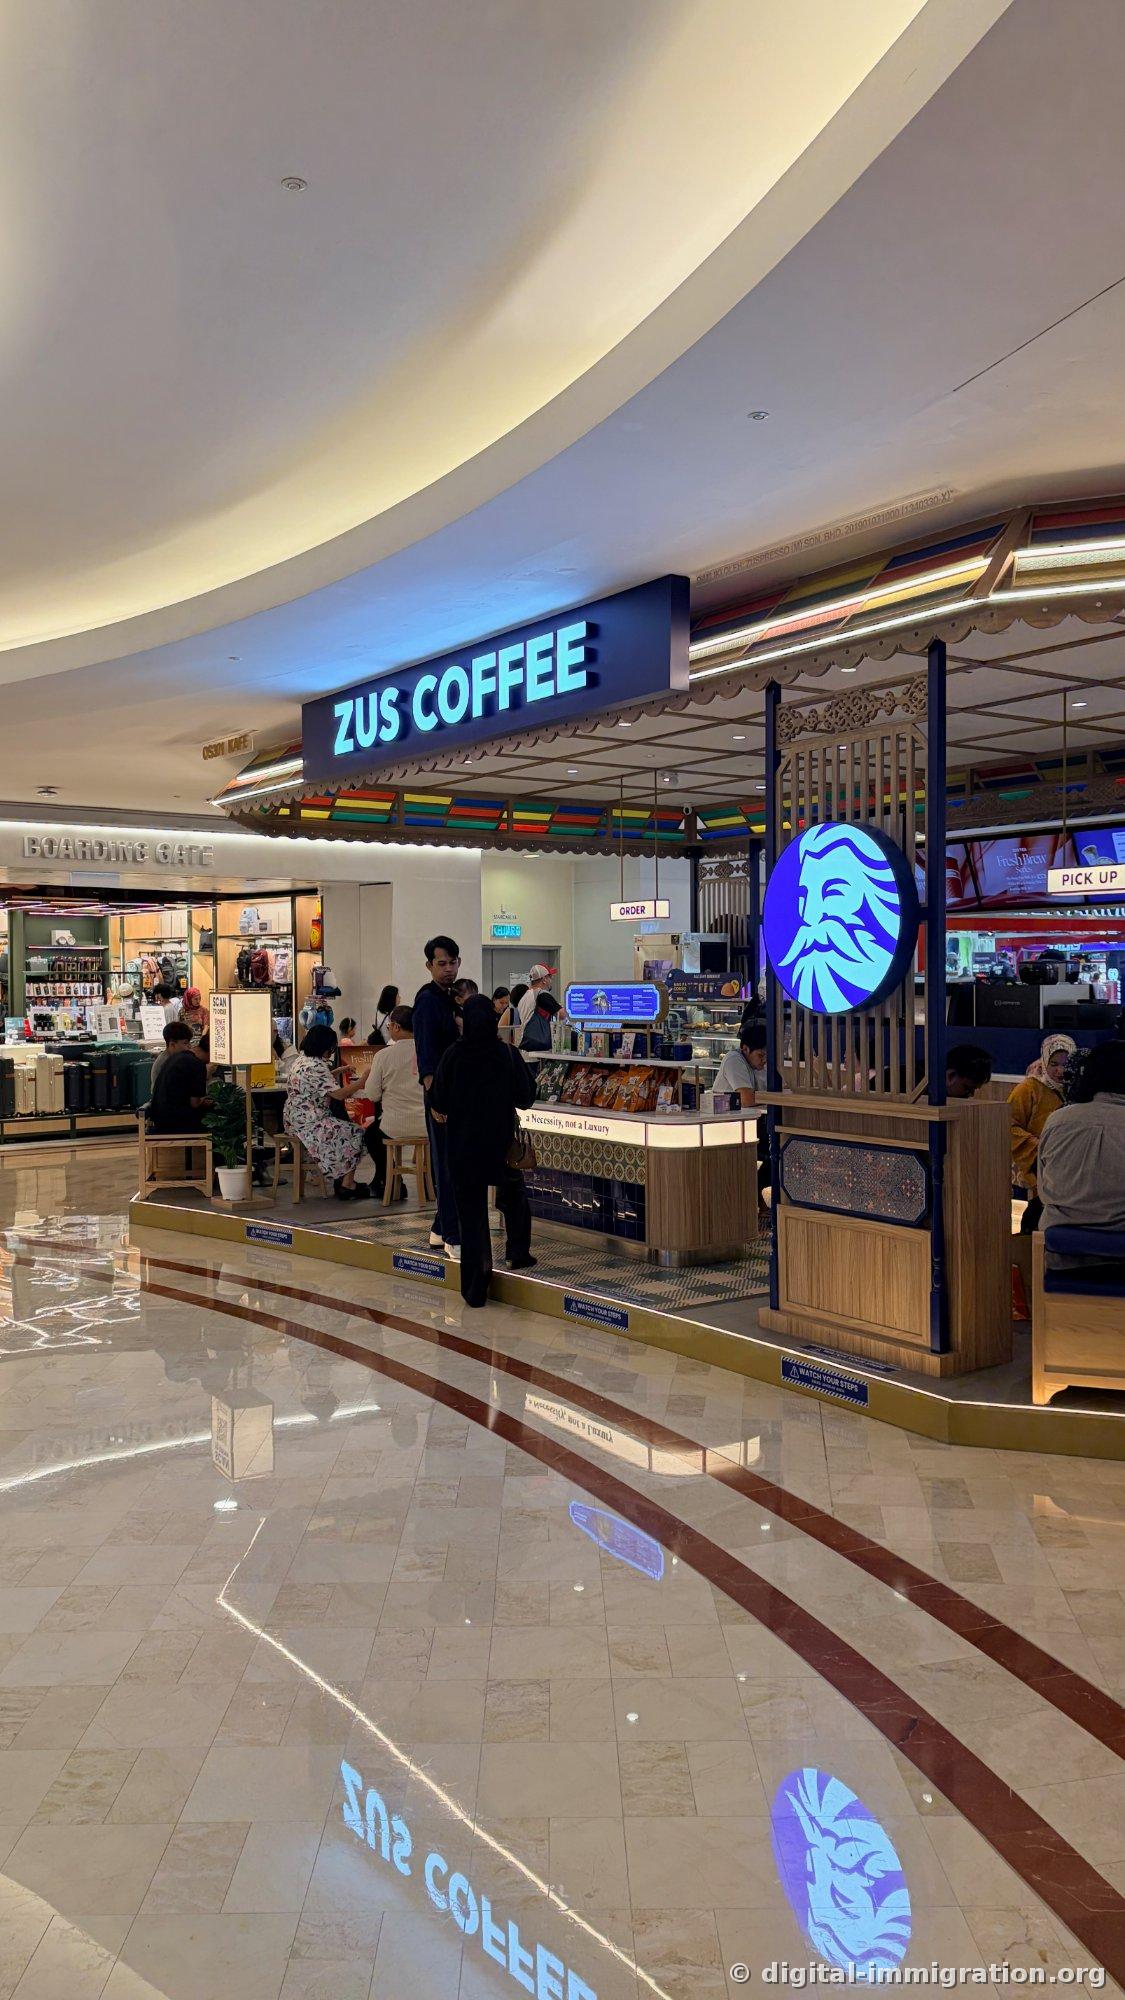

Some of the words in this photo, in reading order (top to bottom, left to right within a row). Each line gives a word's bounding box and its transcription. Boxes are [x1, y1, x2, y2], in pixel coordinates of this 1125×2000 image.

[334, 687, 400, 756] ZUS
[412, 620, 587, 732] COFFEE
[228, 735, 248, 753] KAFE
[23, 835, 149, 863] BOARDING
[155, 842, 214, 866] GATE
[1062, 872, 1093, 886] PICK
[1100, 870, 1118, 884] UP
[619, 905, 646, 916] ORDER
[212, 996, 227, 1008] SCAN
[531, 1113, 563, 1129] Necessity,
[565, 1120, 576, 1129] not
[578, 1122, 583, 1130] a
[584, 1120, 610, 1136] Luxury
[577, 1302, 595, 1312] WATCH
[595, 1307, 608, 1316] YOUR
[608, 1311, 622, 1320] STEPS
[800, 1368, 822, 1380] WATCH
[822, 1373, 840, 1387] YOUR
[840, 1380, 859, 1393] STEPS
